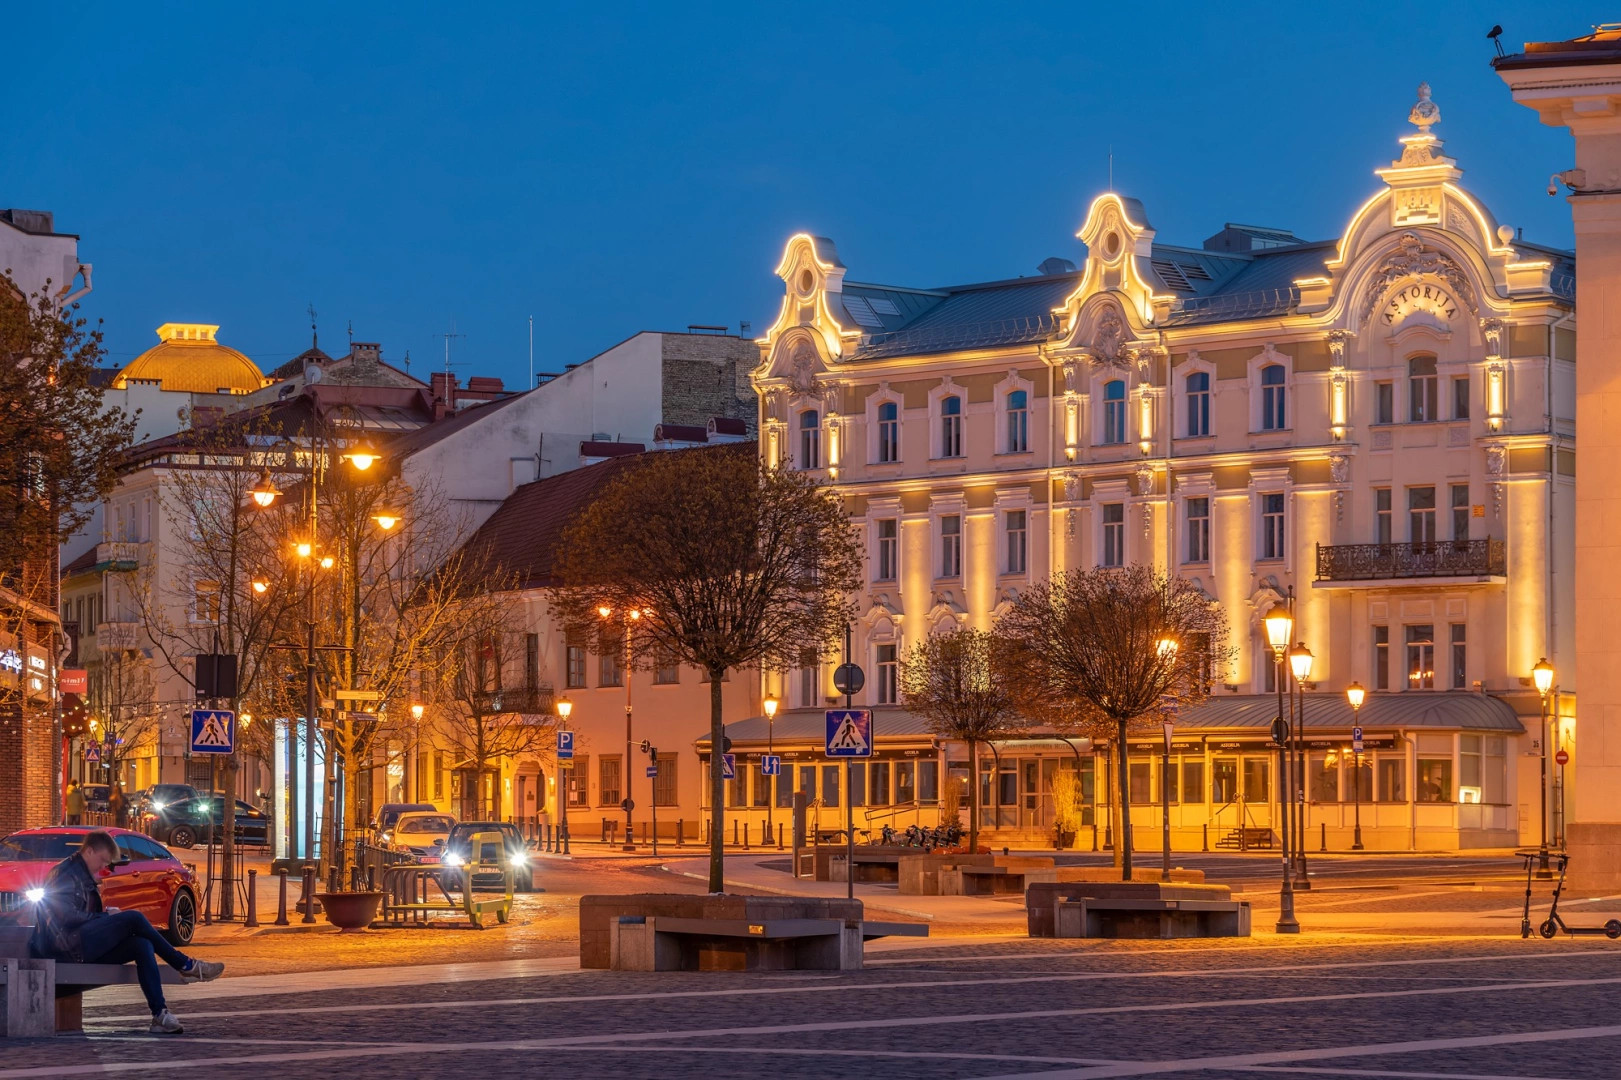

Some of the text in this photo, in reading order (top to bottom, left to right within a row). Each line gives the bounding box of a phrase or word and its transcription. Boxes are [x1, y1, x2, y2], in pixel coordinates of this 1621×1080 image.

[1384, 286, 1457, 323] ASTORIJA
[560, 733, 571, 748] P
[1354, 728, 1361, 740] P
